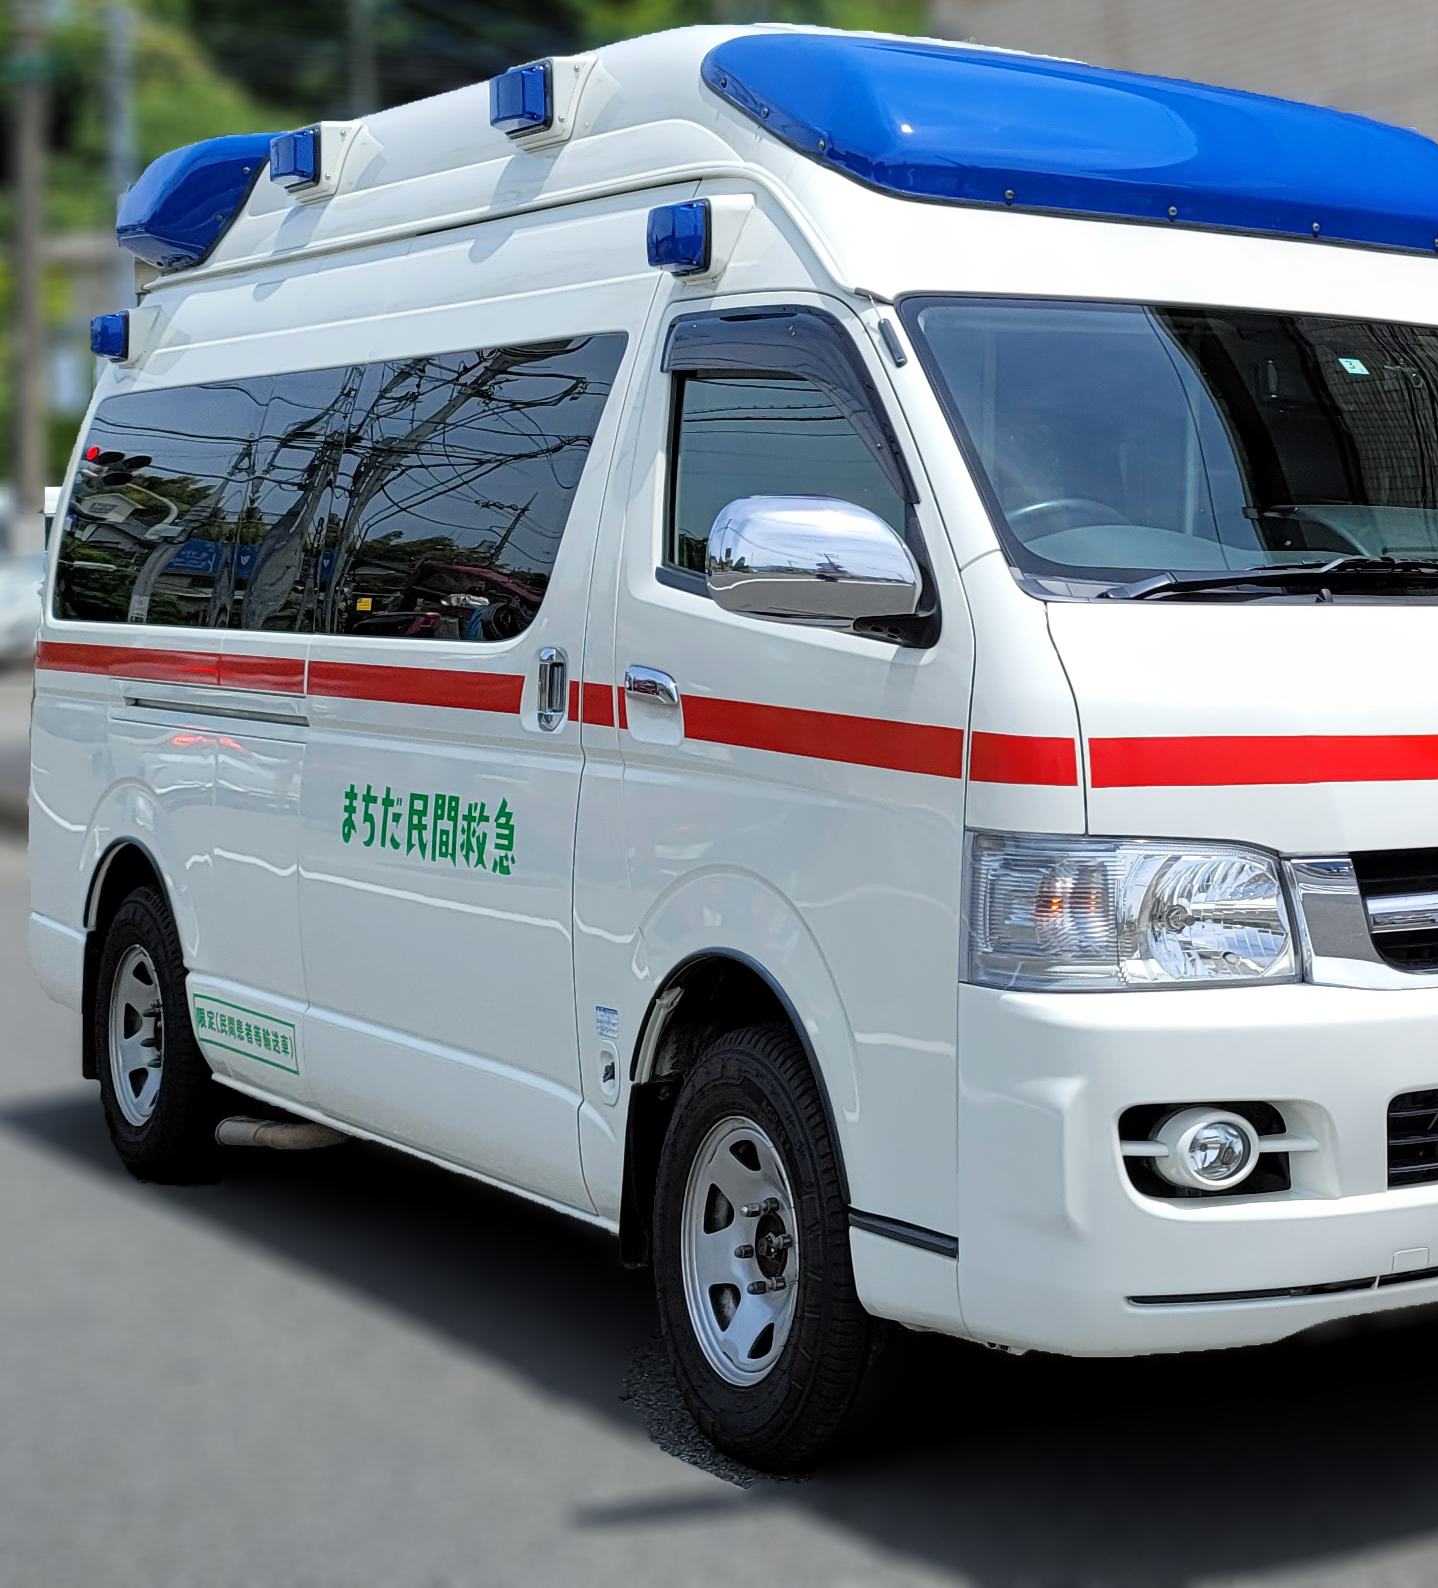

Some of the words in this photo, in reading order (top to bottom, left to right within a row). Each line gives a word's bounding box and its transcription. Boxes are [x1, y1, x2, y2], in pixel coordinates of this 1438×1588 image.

[341, 783, 516, 876] まちだ民間救急
